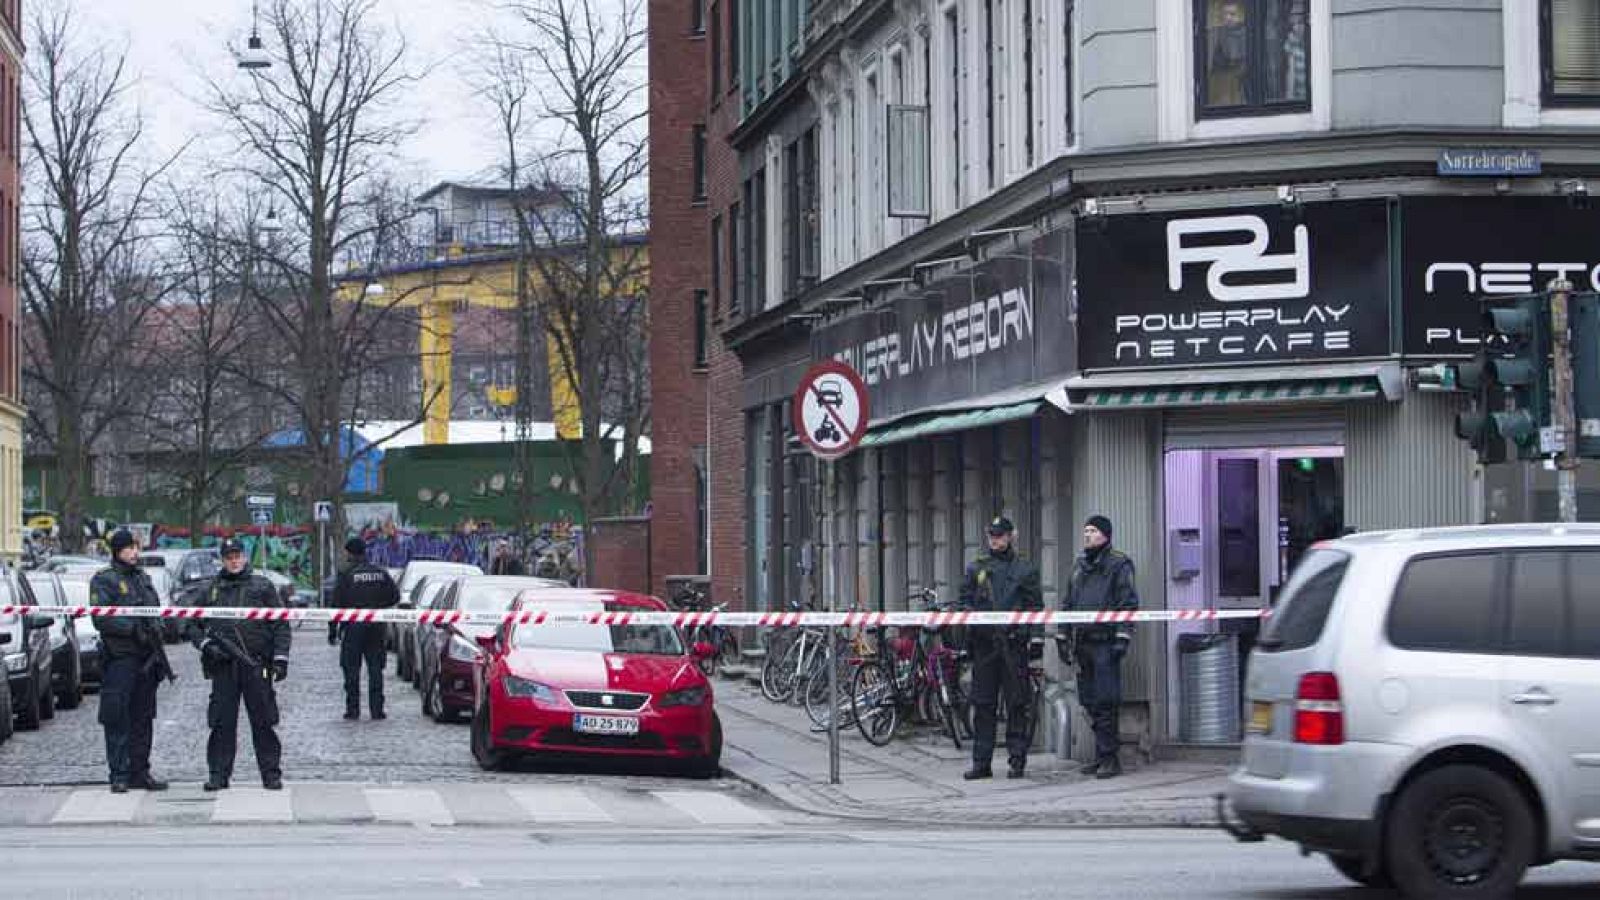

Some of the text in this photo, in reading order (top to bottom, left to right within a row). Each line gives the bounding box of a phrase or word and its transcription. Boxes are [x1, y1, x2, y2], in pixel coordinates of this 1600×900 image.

[832, 281, 1033, 386] WERPLAY REBORN
[1115, 304, 1351, 334] POWERPLAY
[1115, 330, 1351, 360] NETCAFE
